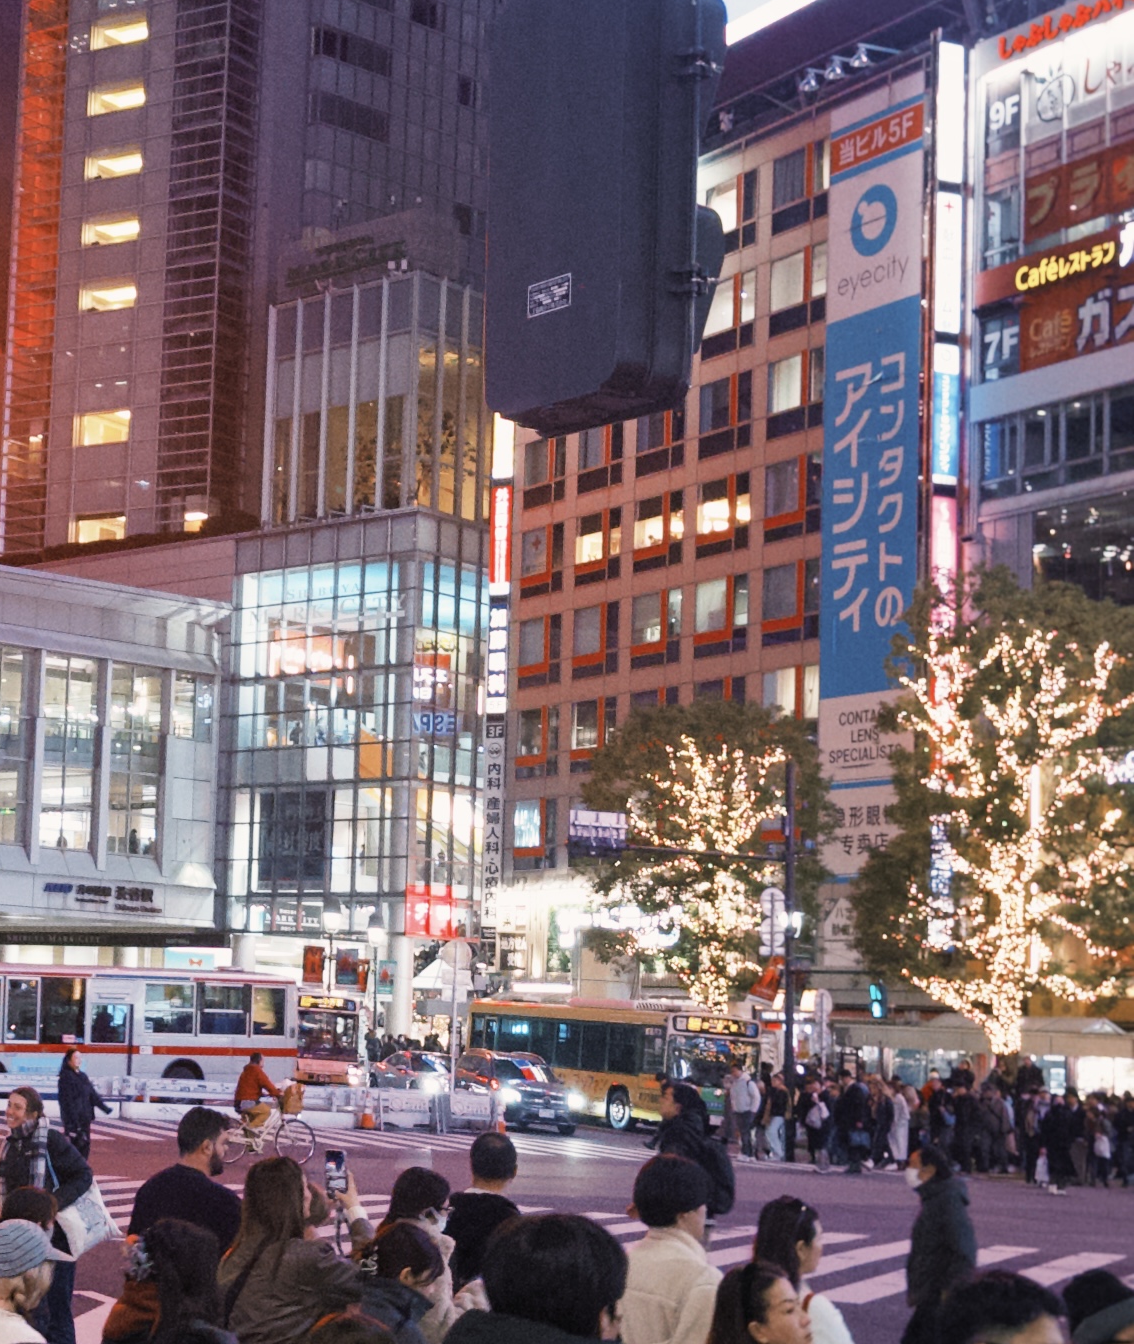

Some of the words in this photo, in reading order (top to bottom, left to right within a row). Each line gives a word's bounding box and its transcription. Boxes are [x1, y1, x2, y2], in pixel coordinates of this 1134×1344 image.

[989, 94, 1020, 131] 9F
[839, 112, 914, 165] 当ビル5F
[838, 255, 909, 301] eyecity
[984, 325, 1020, 364] 7F
[831, 362, 872, 633] アイシティ
[874, 352, 905, 627] コンタクトの
[487, 725, 504, 738] 3F
[851, 727, 880, 744] LENS
[487, 763, 502, 791] 内科
